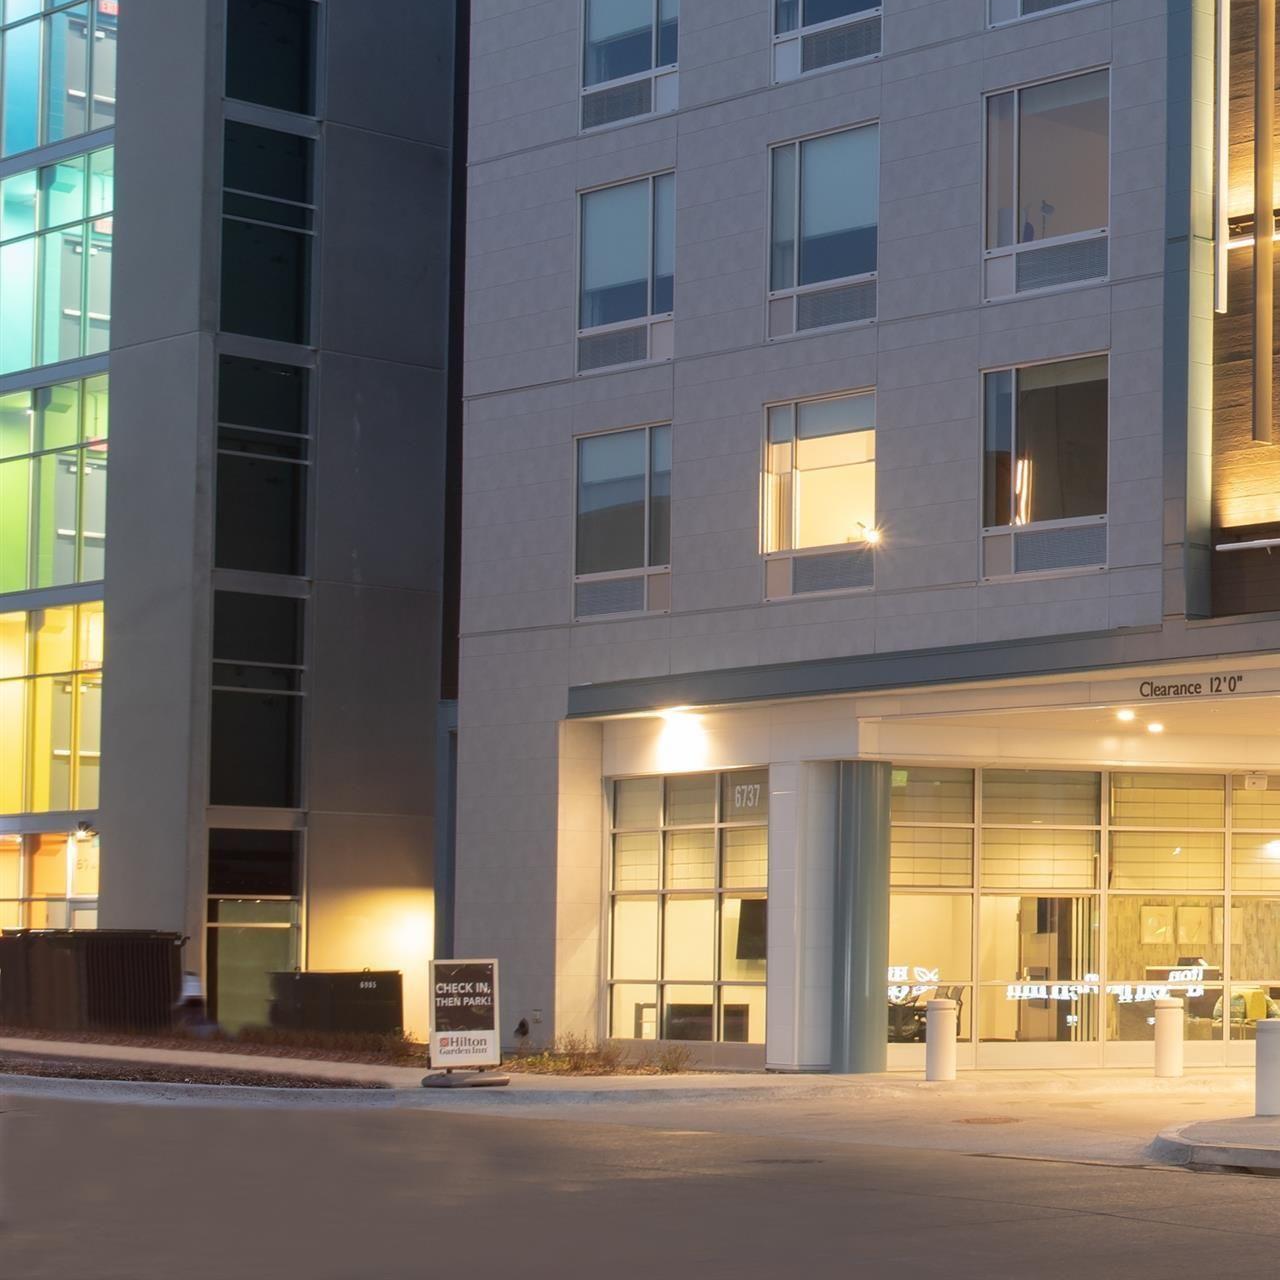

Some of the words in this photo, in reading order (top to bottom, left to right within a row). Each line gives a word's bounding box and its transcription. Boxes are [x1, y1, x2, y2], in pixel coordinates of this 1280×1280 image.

[1139, 681, 1202, 697] Clearance
[735, 784, 760, 808] 6737
[435, 982, 473, 994] CHECK
[476, 982, 491, 994] IN,
[436, 997, 461, 1007] THEN
[463, 996, 491, 1006] PARK!
[450, 1036, 487, 1047] Hilton
[439, 1046, 471, 1055] Garden
[472, 1046, 488, 1054] Inn
